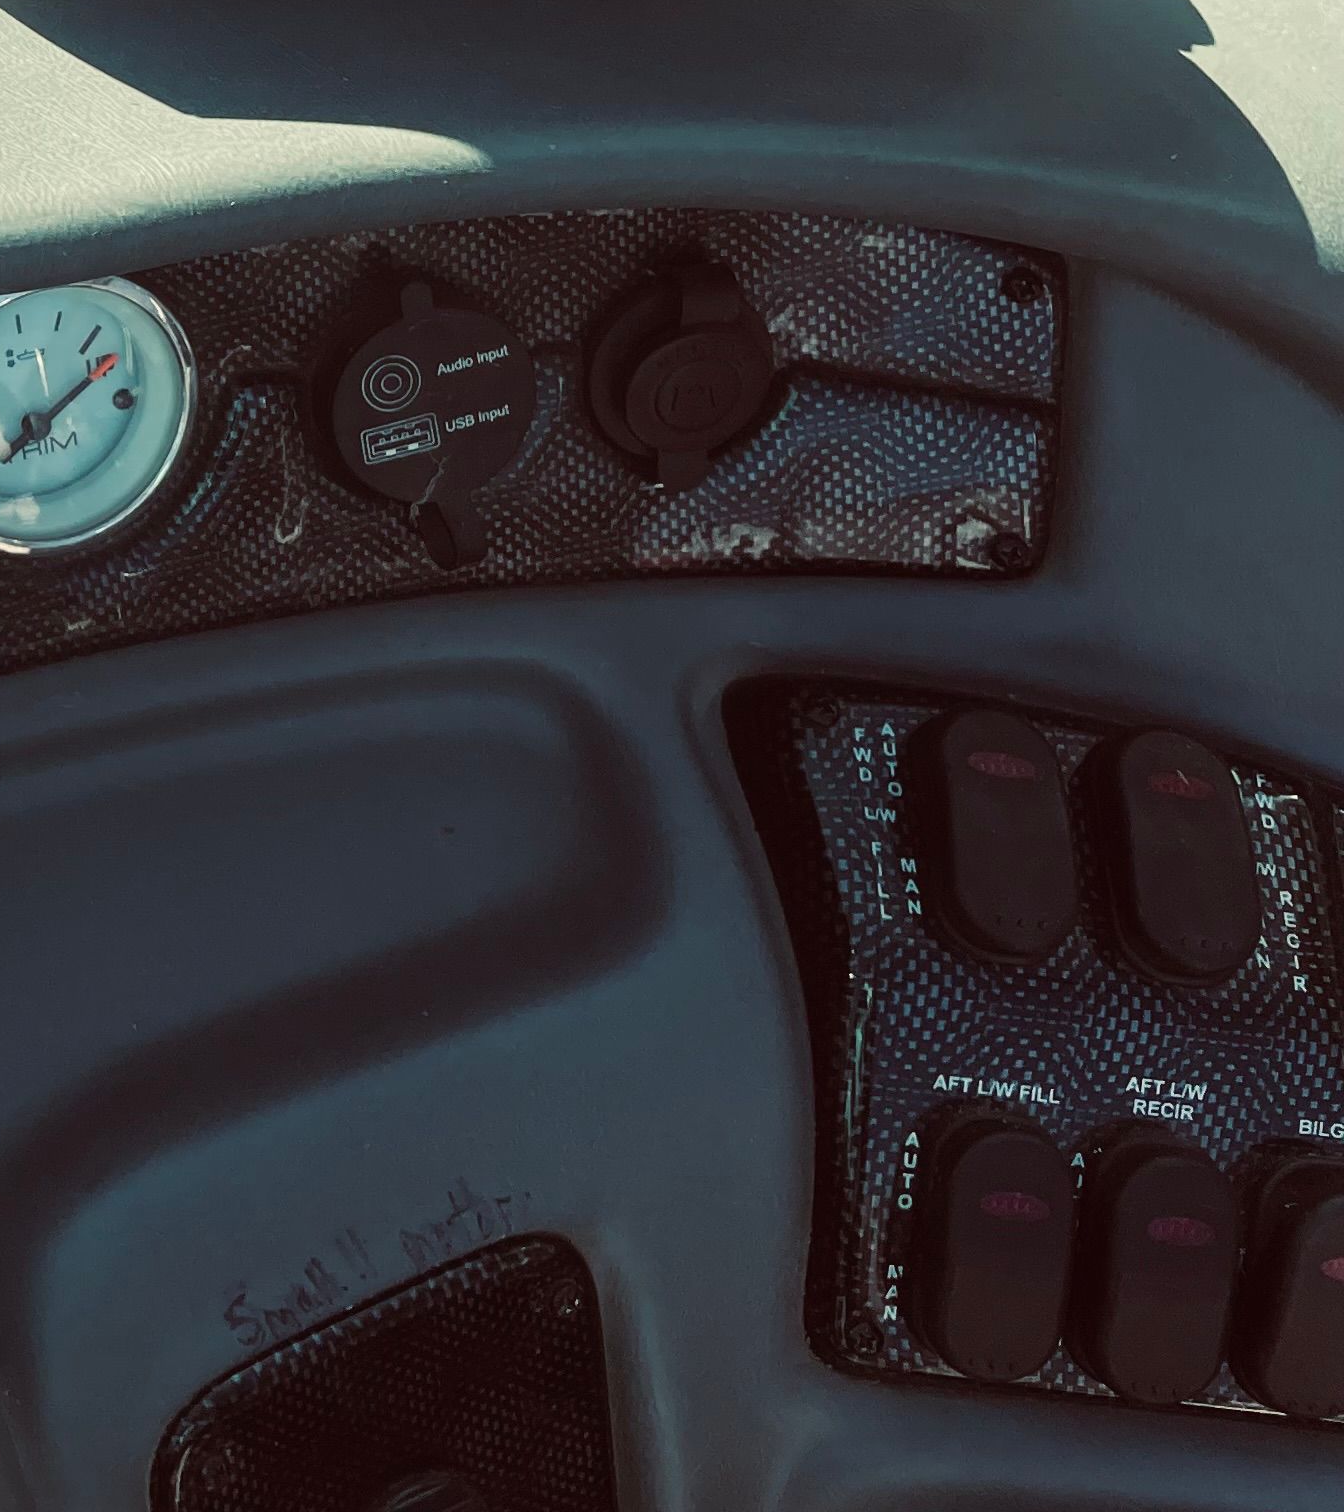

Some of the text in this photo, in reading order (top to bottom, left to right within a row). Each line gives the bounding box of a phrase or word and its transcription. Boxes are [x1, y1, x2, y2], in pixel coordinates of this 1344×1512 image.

[437, 344, 509, 377] Audio Input
[445, 404, 510, 433] USB Input
[9, 431, 79, 464] RIM
[933, 1074, 1061, 1106] AFT L/W FILL
[1126, 1076, 1208, 1101] AFT L/W
[1133, 1099, 1195, 1122] RECIR
